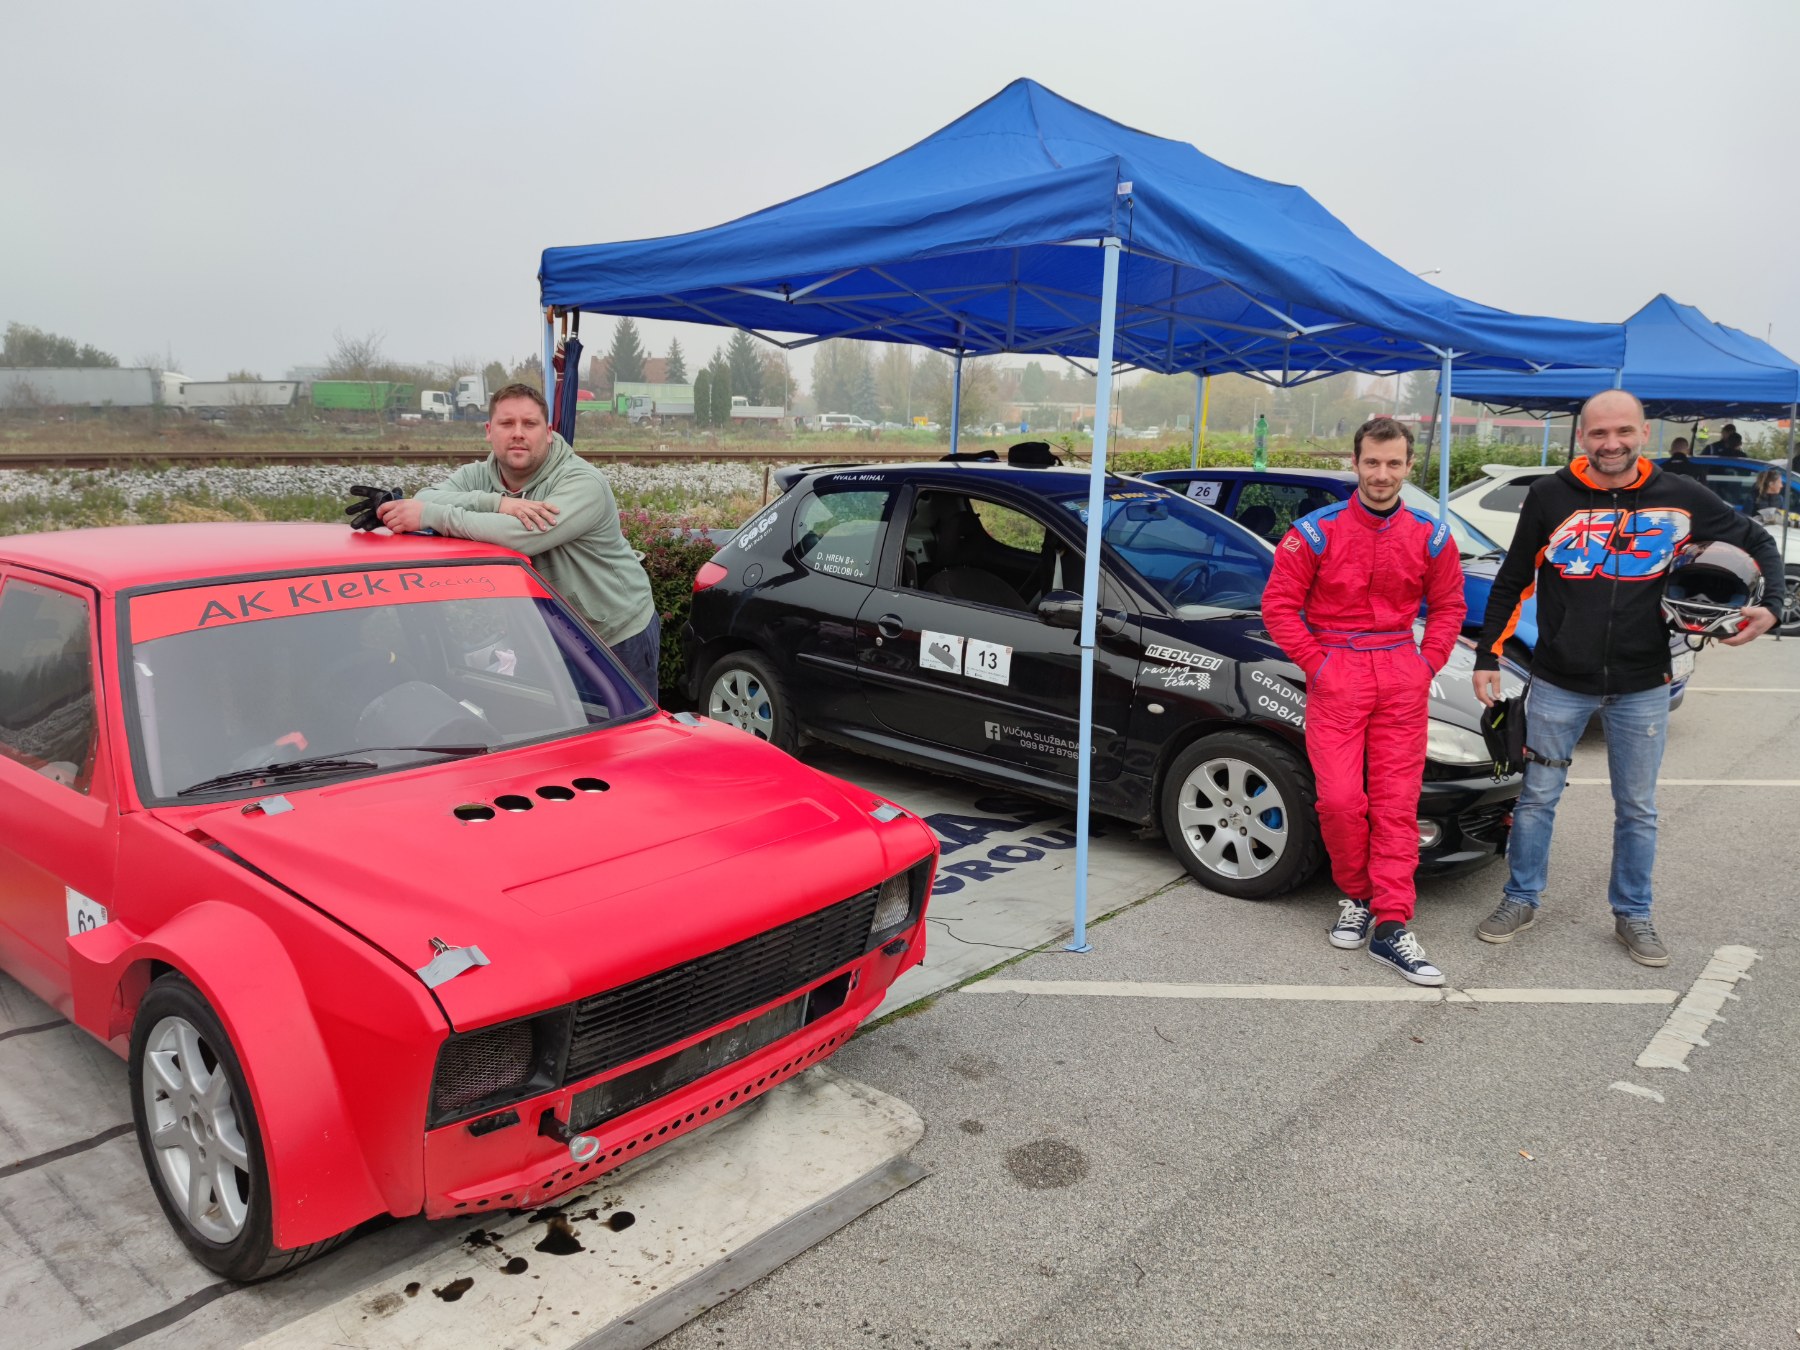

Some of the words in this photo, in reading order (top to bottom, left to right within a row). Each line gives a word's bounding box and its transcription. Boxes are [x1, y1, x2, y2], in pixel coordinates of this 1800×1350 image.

[1195, 486, 1211, 497] 26
[1545, 507, 1692, 581] 43
[816, 552, 824, 561] D.
[826, 553, 844, 563] HREN
[844, 556, 854, 565] B+
[814, 562, 822, 571] D.
[823, 563, 853, 576] MEDLOBI
[197, 590, 271, 626] AK
[287, 573, 390, 608] Klek
[398, 572, 496, 592] Racing
[978, 650, 998, 670] 13
[1145, 644, 1223, 671] MEDLOBI
[1142, 663, 1191, 680] racing
[1161, 672, 1197, 687] team
[1258, 695, 1306, 730] 098/4
[1002, 725, 1032, 740] VUČNA
[1033, 732, 1067, 748] SLUŽBA
[1068, 740, 1097, 754] DAO
[1020, 739, 1037, 750] 099
[1038, 743, 1055, 754] 872
[1056, 748, 1080, 760] 8796
